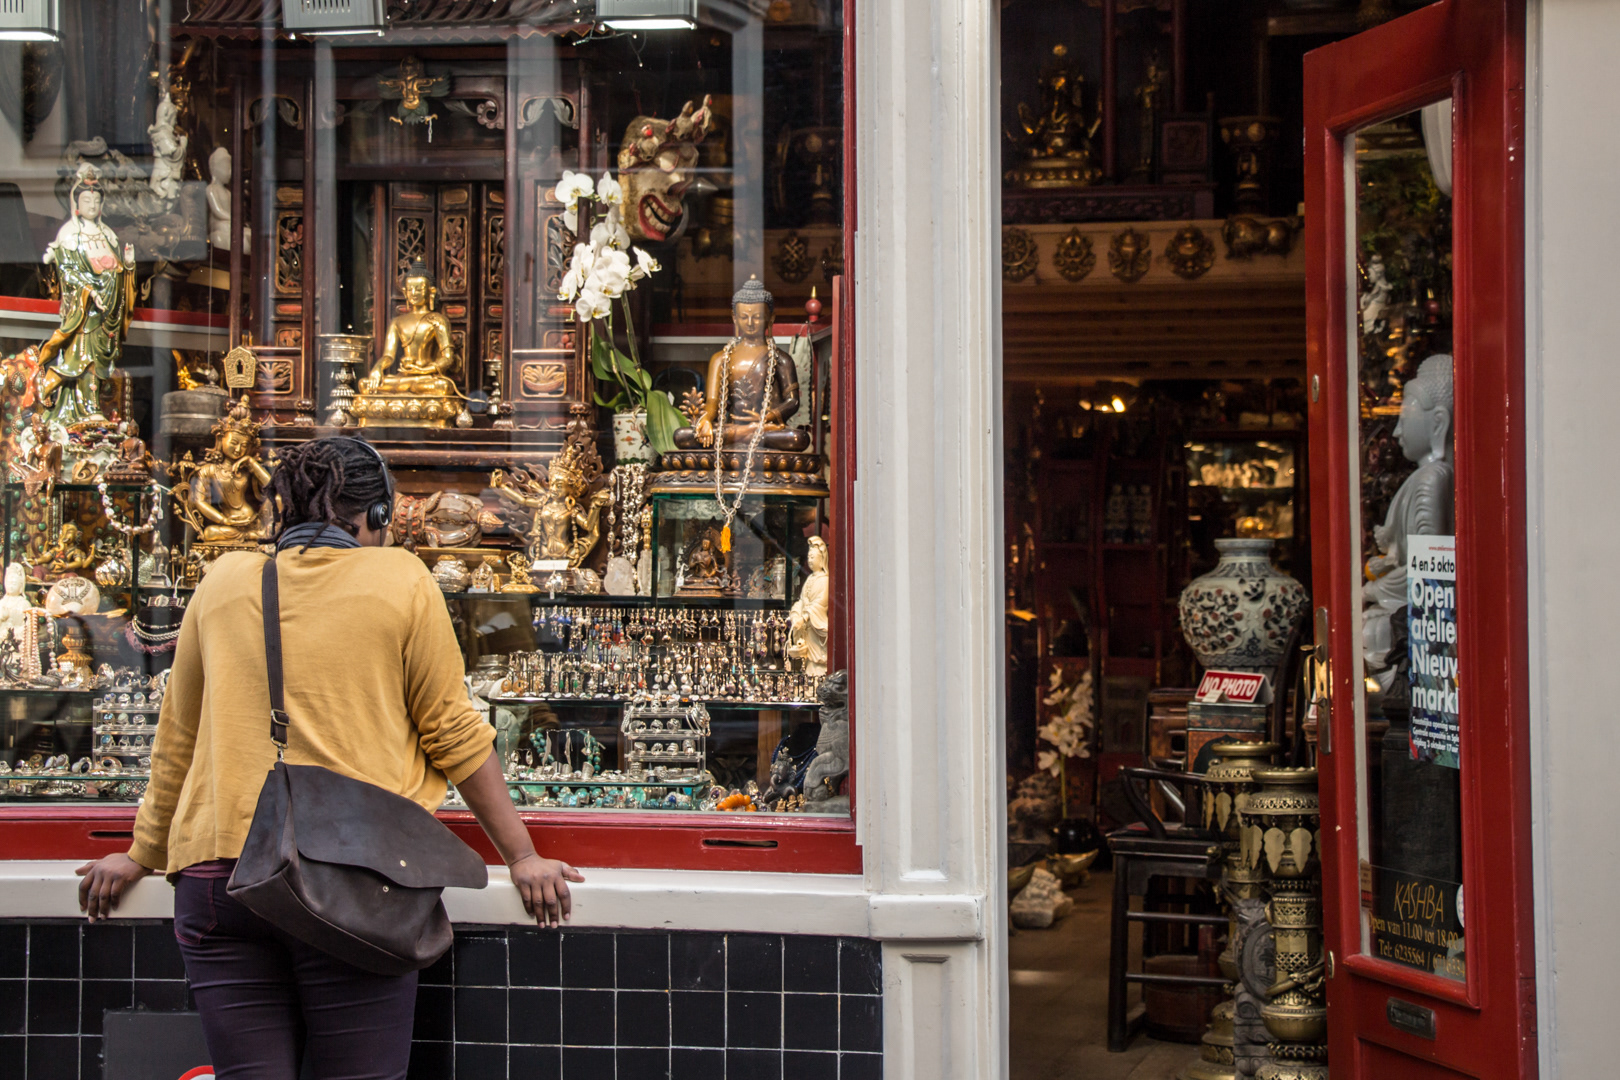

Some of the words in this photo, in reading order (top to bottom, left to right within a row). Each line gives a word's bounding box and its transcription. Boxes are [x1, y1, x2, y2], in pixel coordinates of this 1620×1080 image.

[1411, 555, 1417, 571] 4
[1419, 560, 1429, 572] en
[1430, 556, 1436, 572] 5
[1437, 555, 1455, 573] okto
[1411, 577, 1455, 616] Open
[1411, 609, 1458, 644] atelie
[1200, 676, 1220, 693] NO
[1220, 677, 1257, 697] PHOTO
[1394, 880, 1444, 927] KASHBA
[1368, 911, 1385, 934] Open
[1387, 921, 1401, 936] van
[1402, 921, 1423, 941] 11.00
[1424, 929, 1435, 945] tot
[1437, 929, 1459, 951] 18.00
[1394, 943, 1425, 967] 6235564
